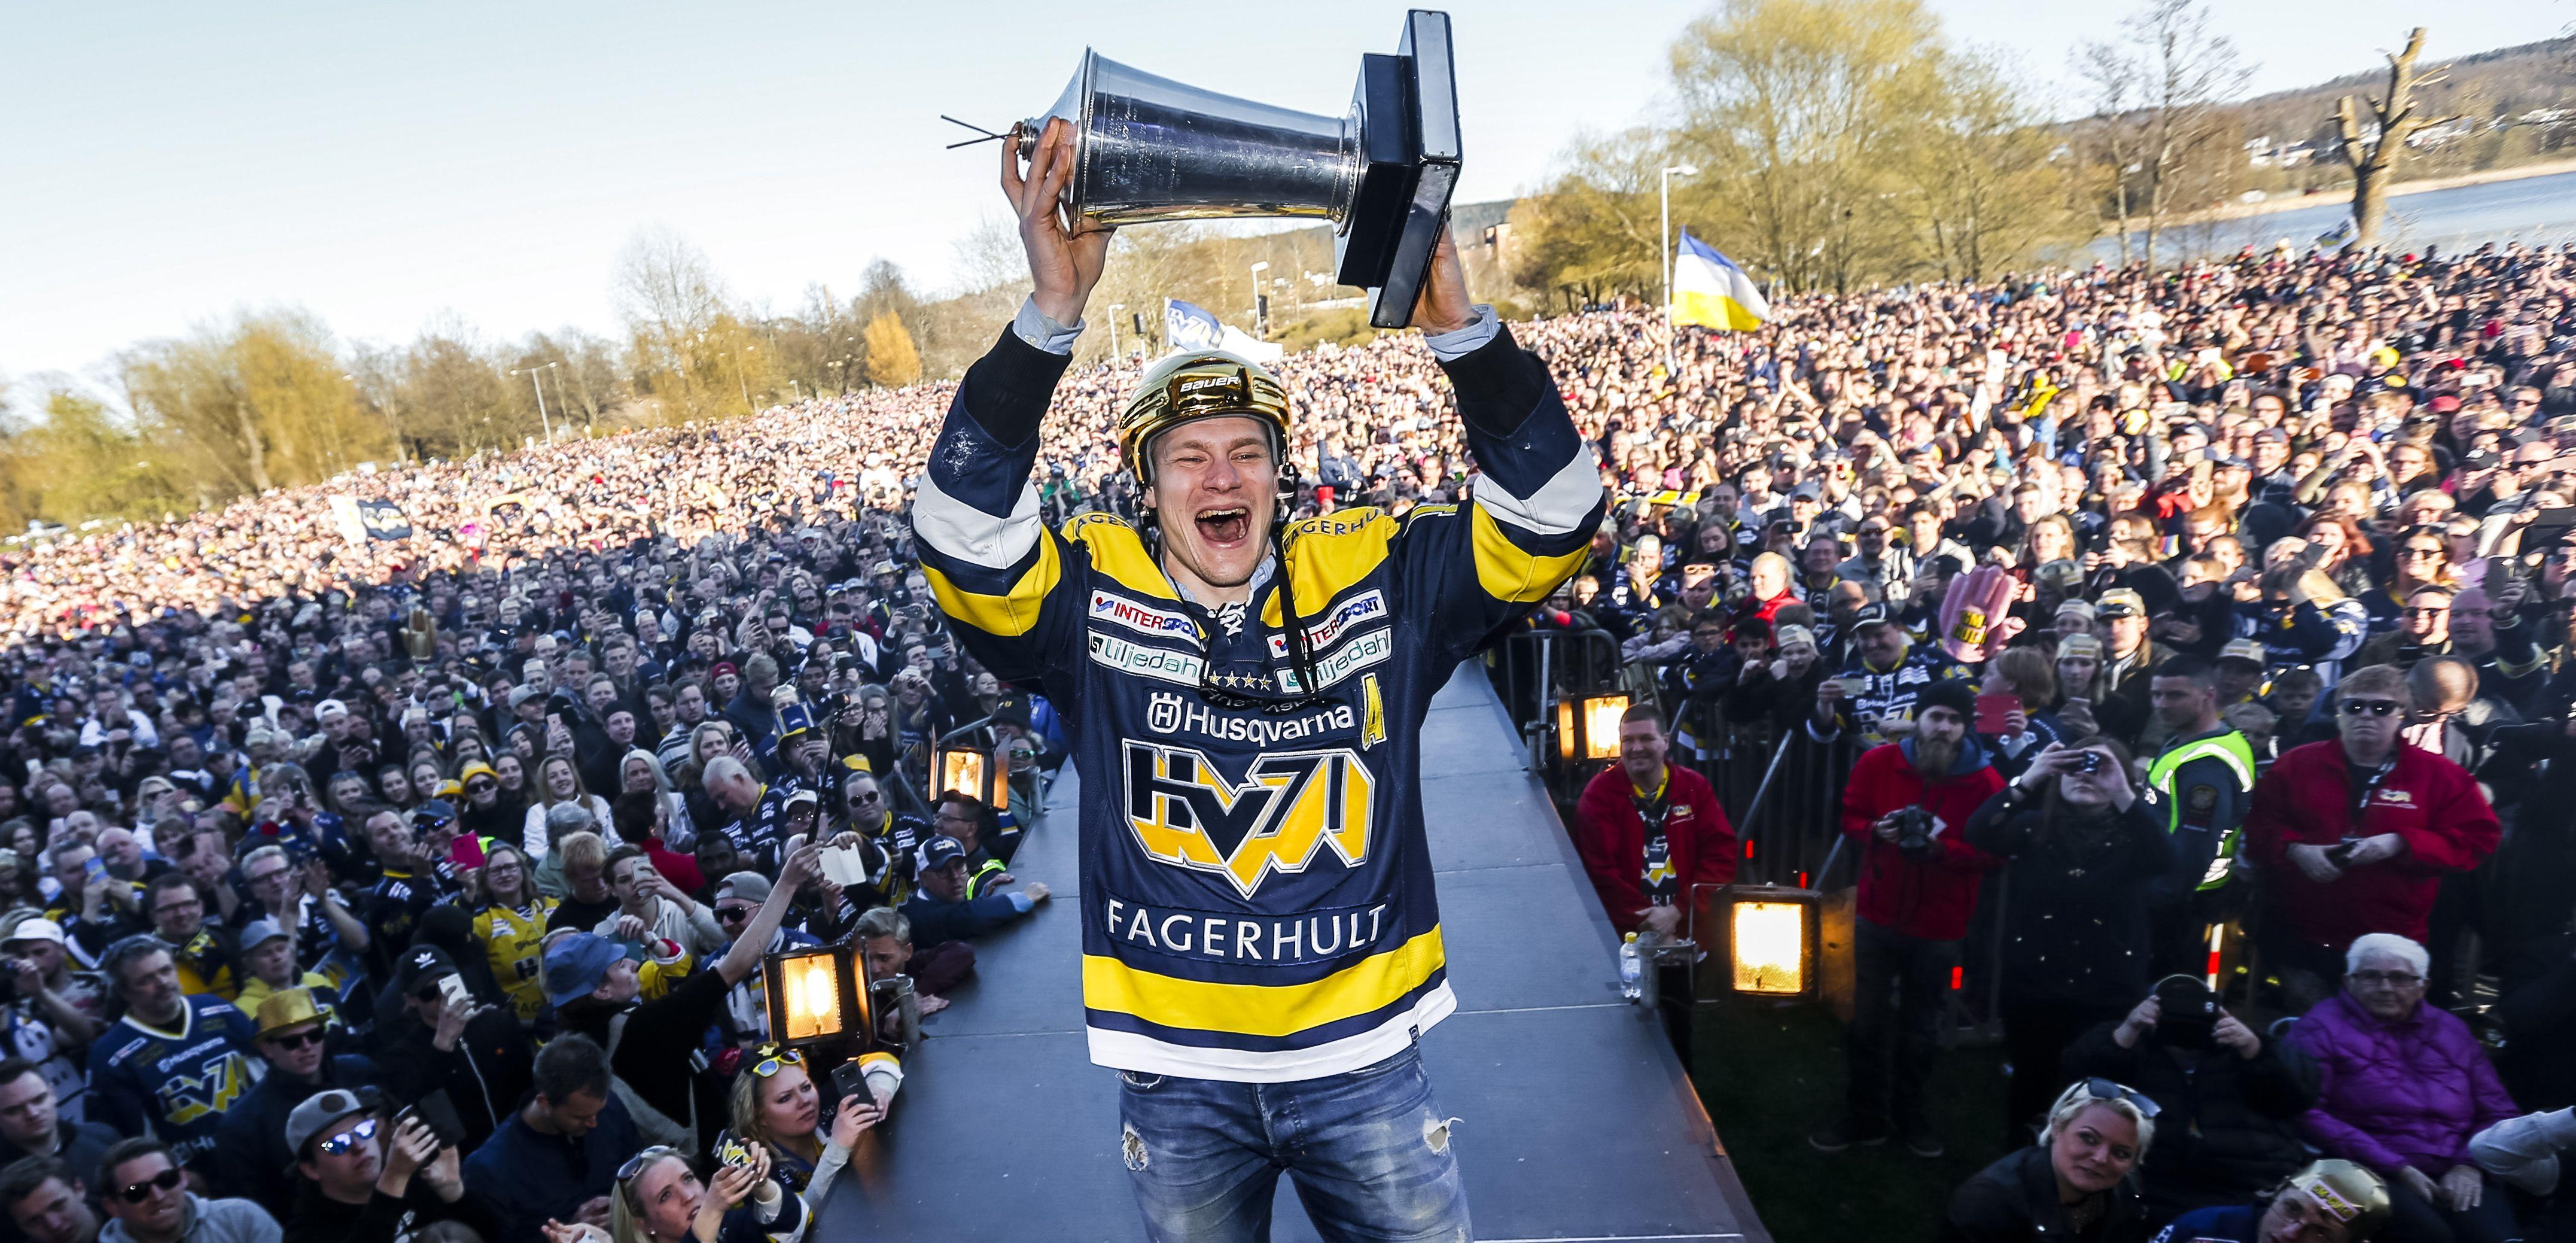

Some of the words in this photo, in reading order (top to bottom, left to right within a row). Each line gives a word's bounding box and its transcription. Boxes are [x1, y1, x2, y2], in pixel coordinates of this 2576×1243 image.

[1114, 602, 1198, 639] INTERSPO
[1301, 596, 1378, 646] TERSPORT
[1105, 638, 1198, 679] Liljedah
[1308, 630, 1389, 683] iljedahl
[1184, 701, 1355, 747] Husqvarna
[1362, 672, 1386, 750] A
[1122, 737, 1375, 901] HV71
[1108, 899, 1386, 961] FAGERHULT
